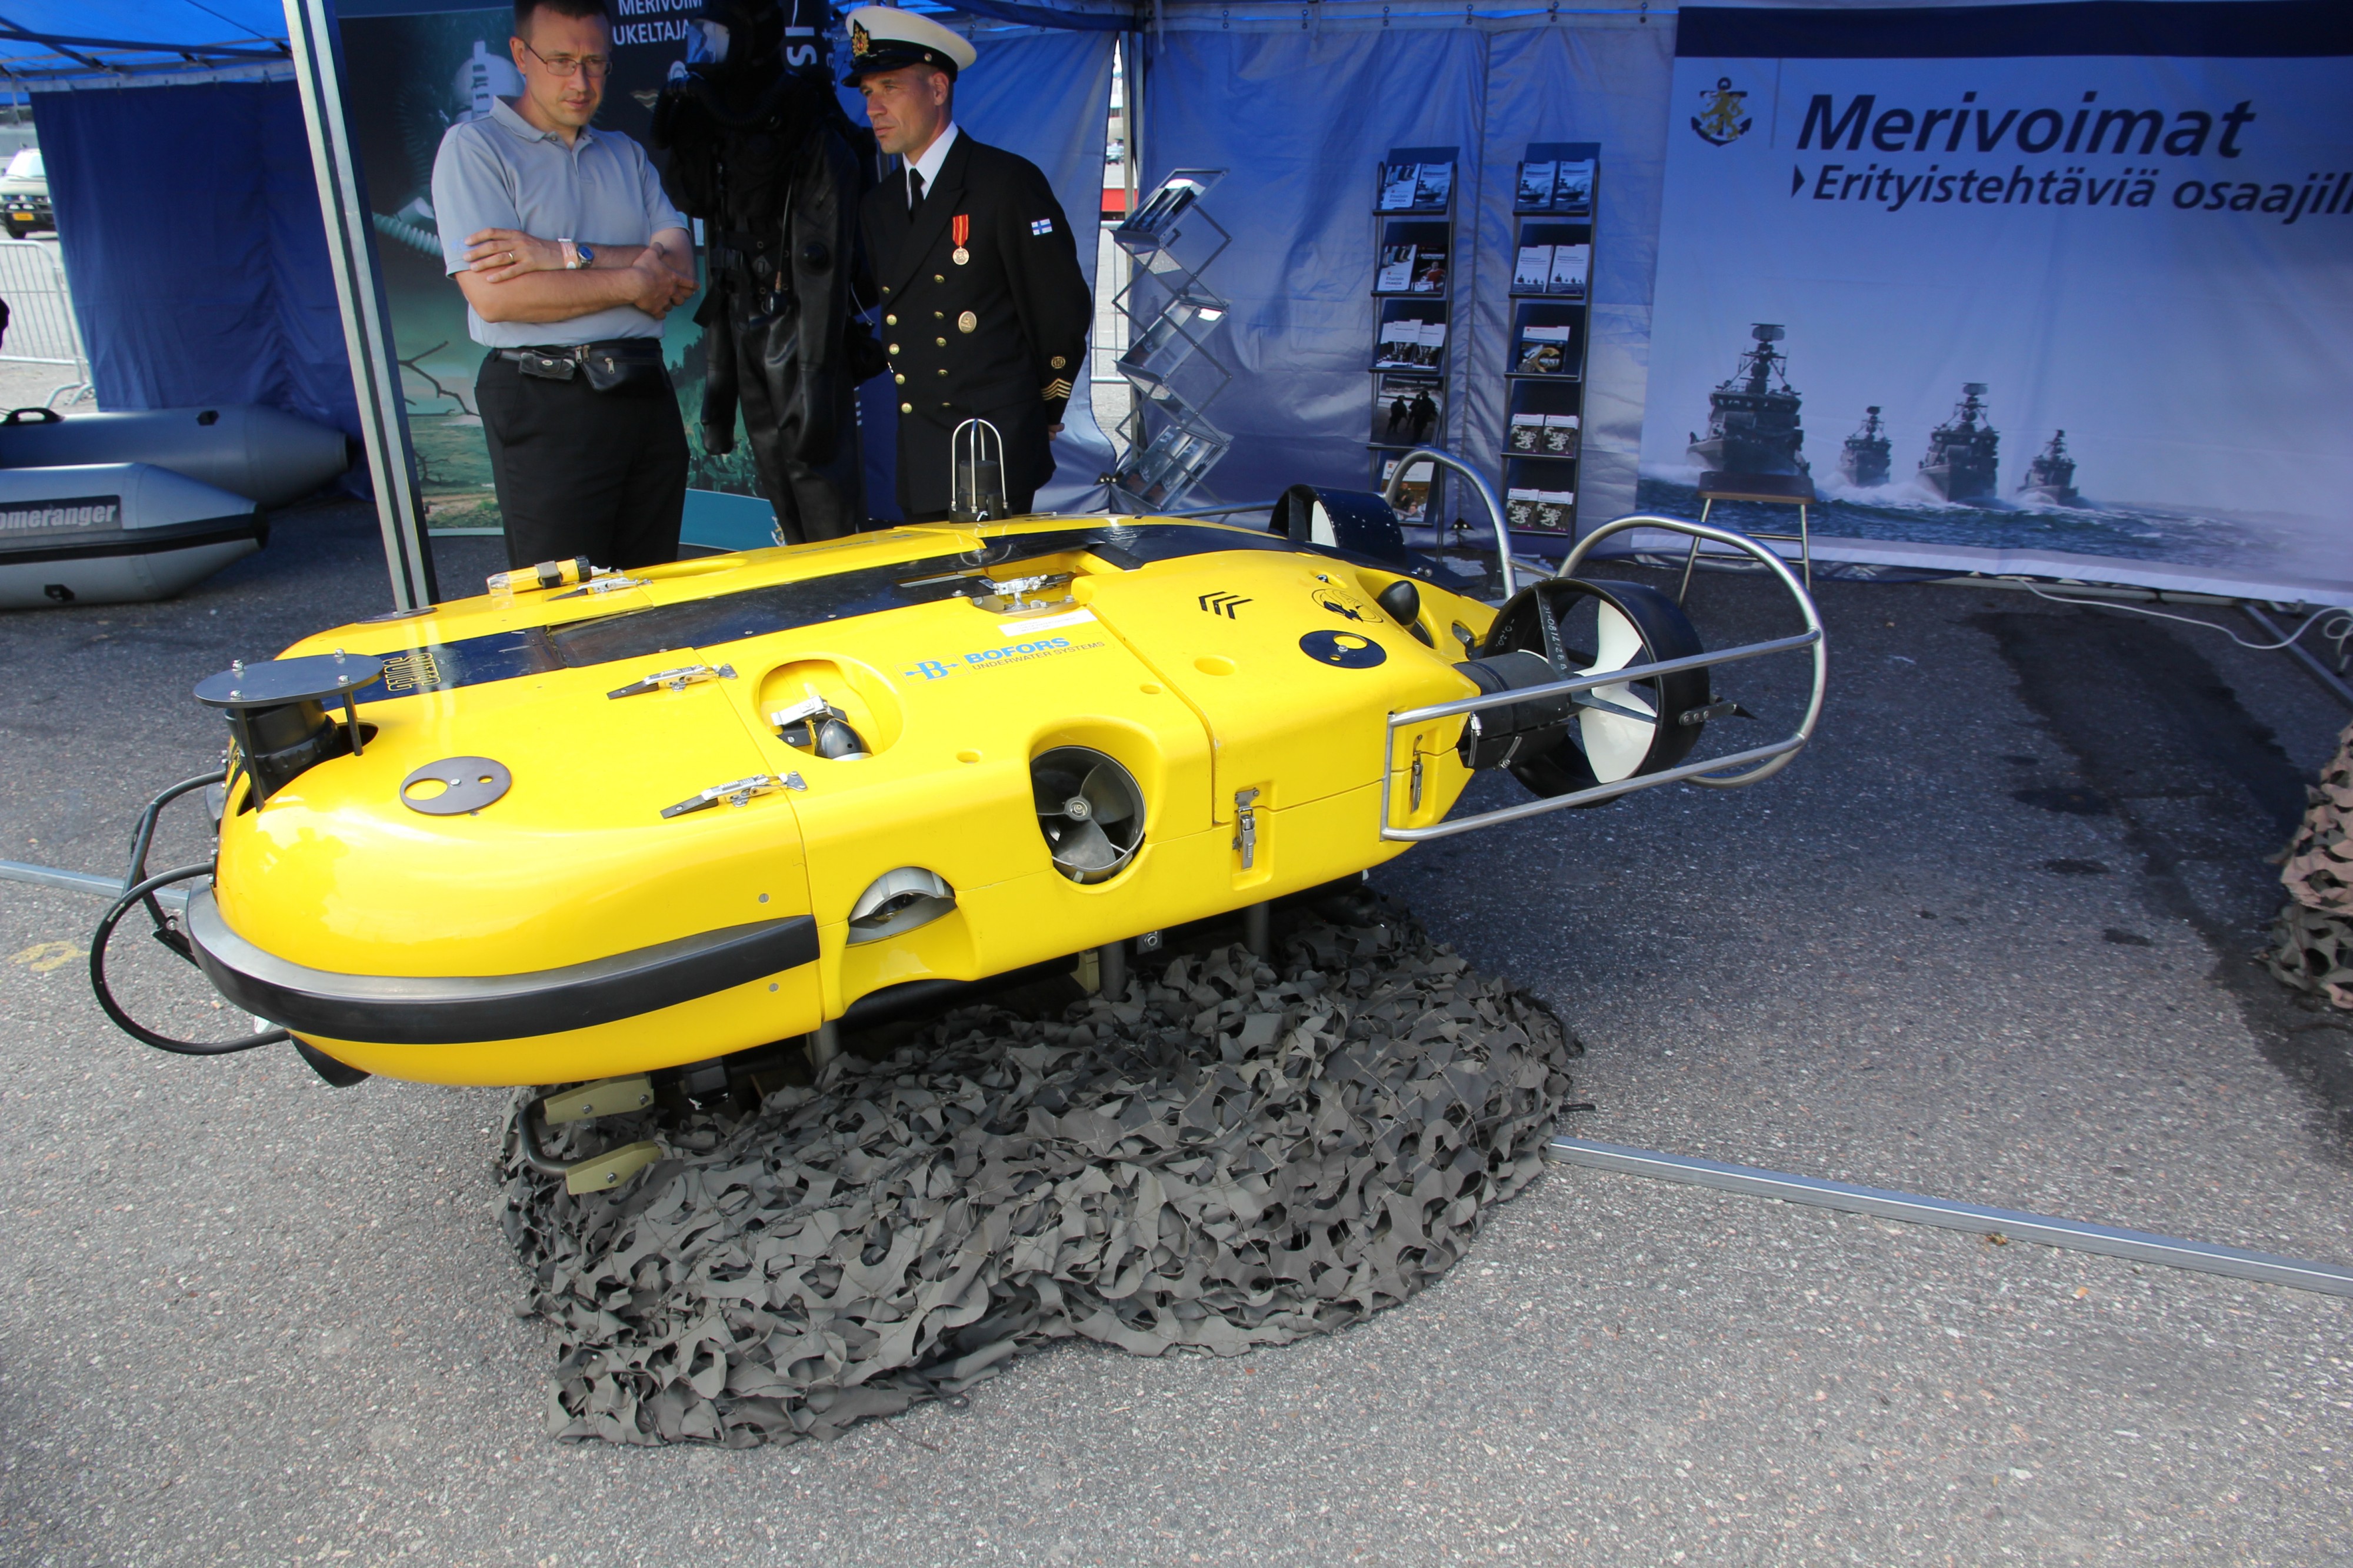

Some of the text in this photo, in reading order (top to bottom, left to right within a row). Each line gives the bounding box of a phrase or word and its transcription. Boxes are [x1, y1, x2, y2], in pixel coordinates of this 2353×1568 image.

[1796, 90, 2257, 159] Merivoimat
[1813, 163, 2159, 212] Erityistehtäviä
[964, 637, 1071, 665] BOFORS
[972, 641, 1106, 670] UNDERWATER SYSTEMS
